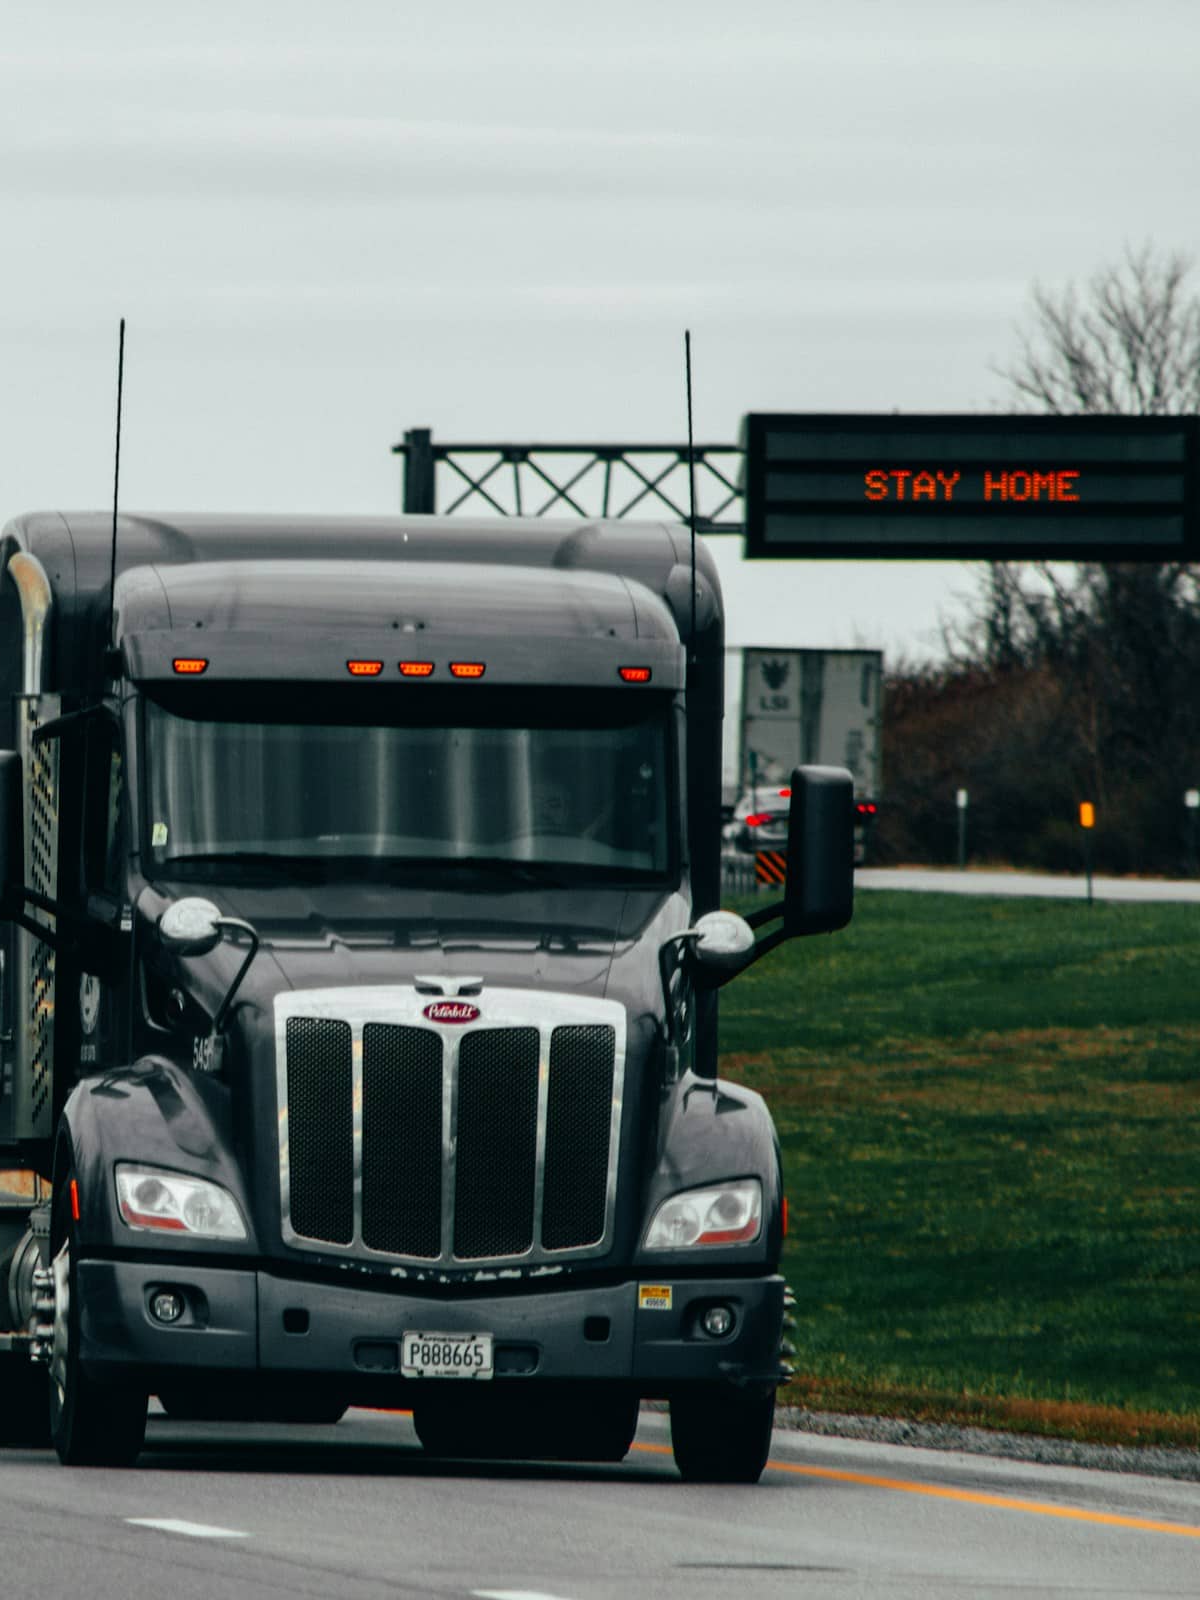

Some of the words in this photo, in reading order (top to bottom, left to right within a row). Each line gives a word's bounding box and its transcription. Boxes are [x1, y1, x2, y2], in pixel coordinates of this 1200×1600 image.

[864, 470, 960, 500] STAY
[984, 470, 1081, 501] HOME
[428, 1004, 474, 1018] Peterbilt
[410, 1343, 484, 1367] P888665
